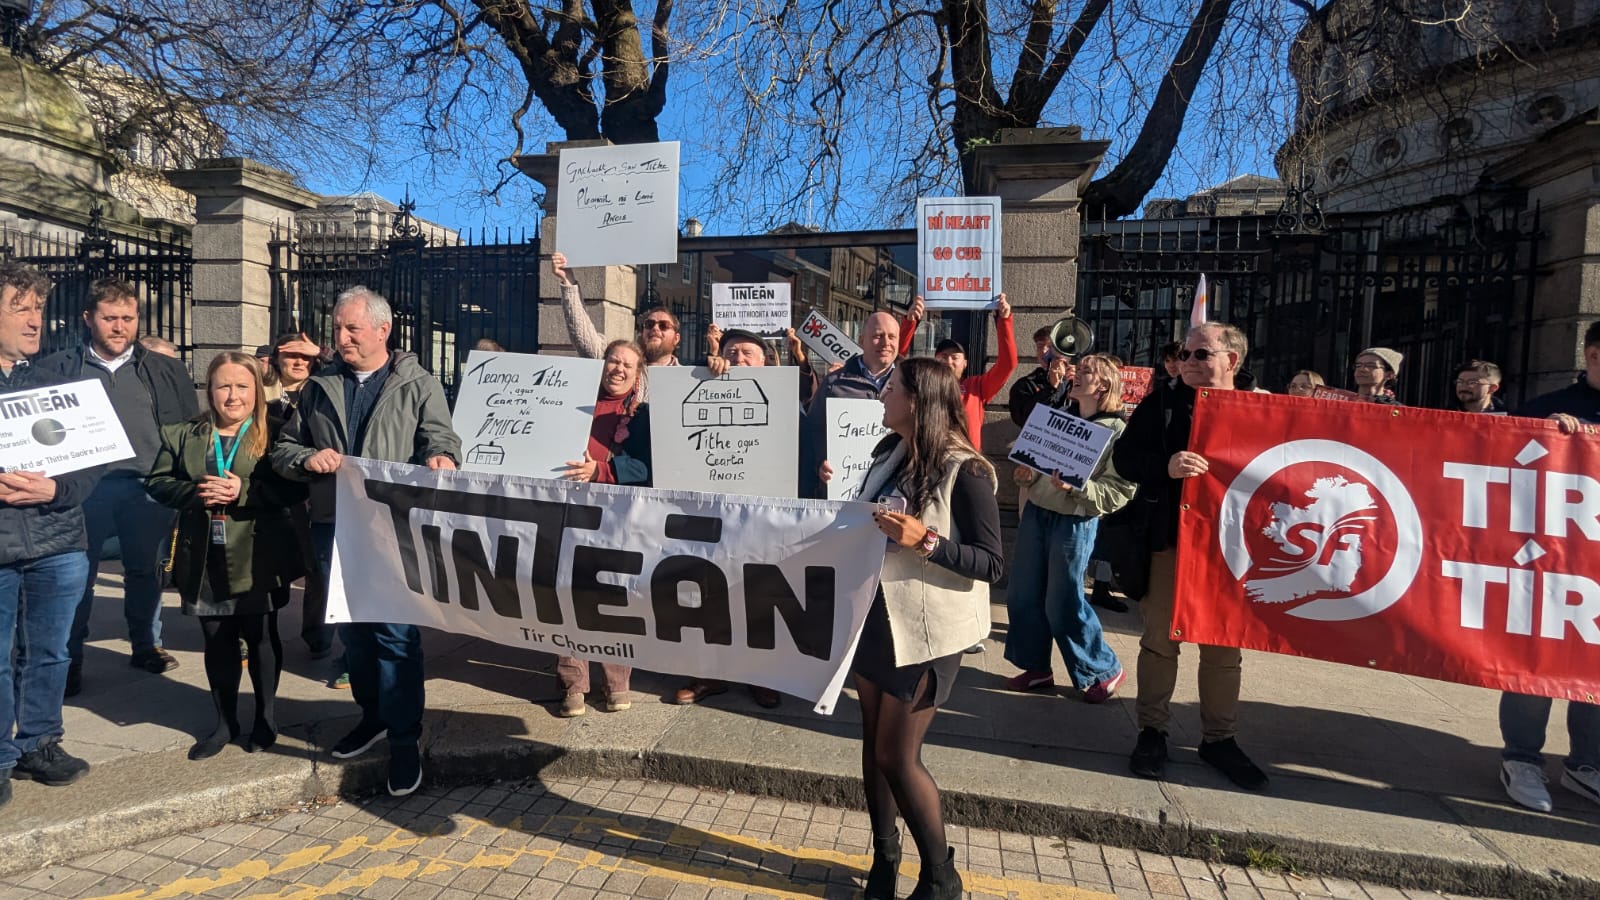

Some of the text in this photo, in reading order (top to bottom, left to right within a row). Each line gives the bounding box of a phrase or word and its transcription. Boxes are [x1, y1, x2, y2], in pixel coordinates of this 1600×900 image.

[927, 210, 991, 230] NÍ NEART
[933, 246, 982, 260] GO CUR
[926, 272, 991, 292] LE CHÉILE
[468, 356, 569, 392] Teanga Tithe
[688, 428, 760, 453] Tithe agus
[1021, 431, 1043, 445] CEARTA
[45, 453, 69, 464] Thithe
[1443, 438, 1600, 541] TÍR
[1284, 521, 1364, 567] SF
[1441, 538, 1600, 645] TÍR
[520, 626, 634, 659] Tír Chonaill
